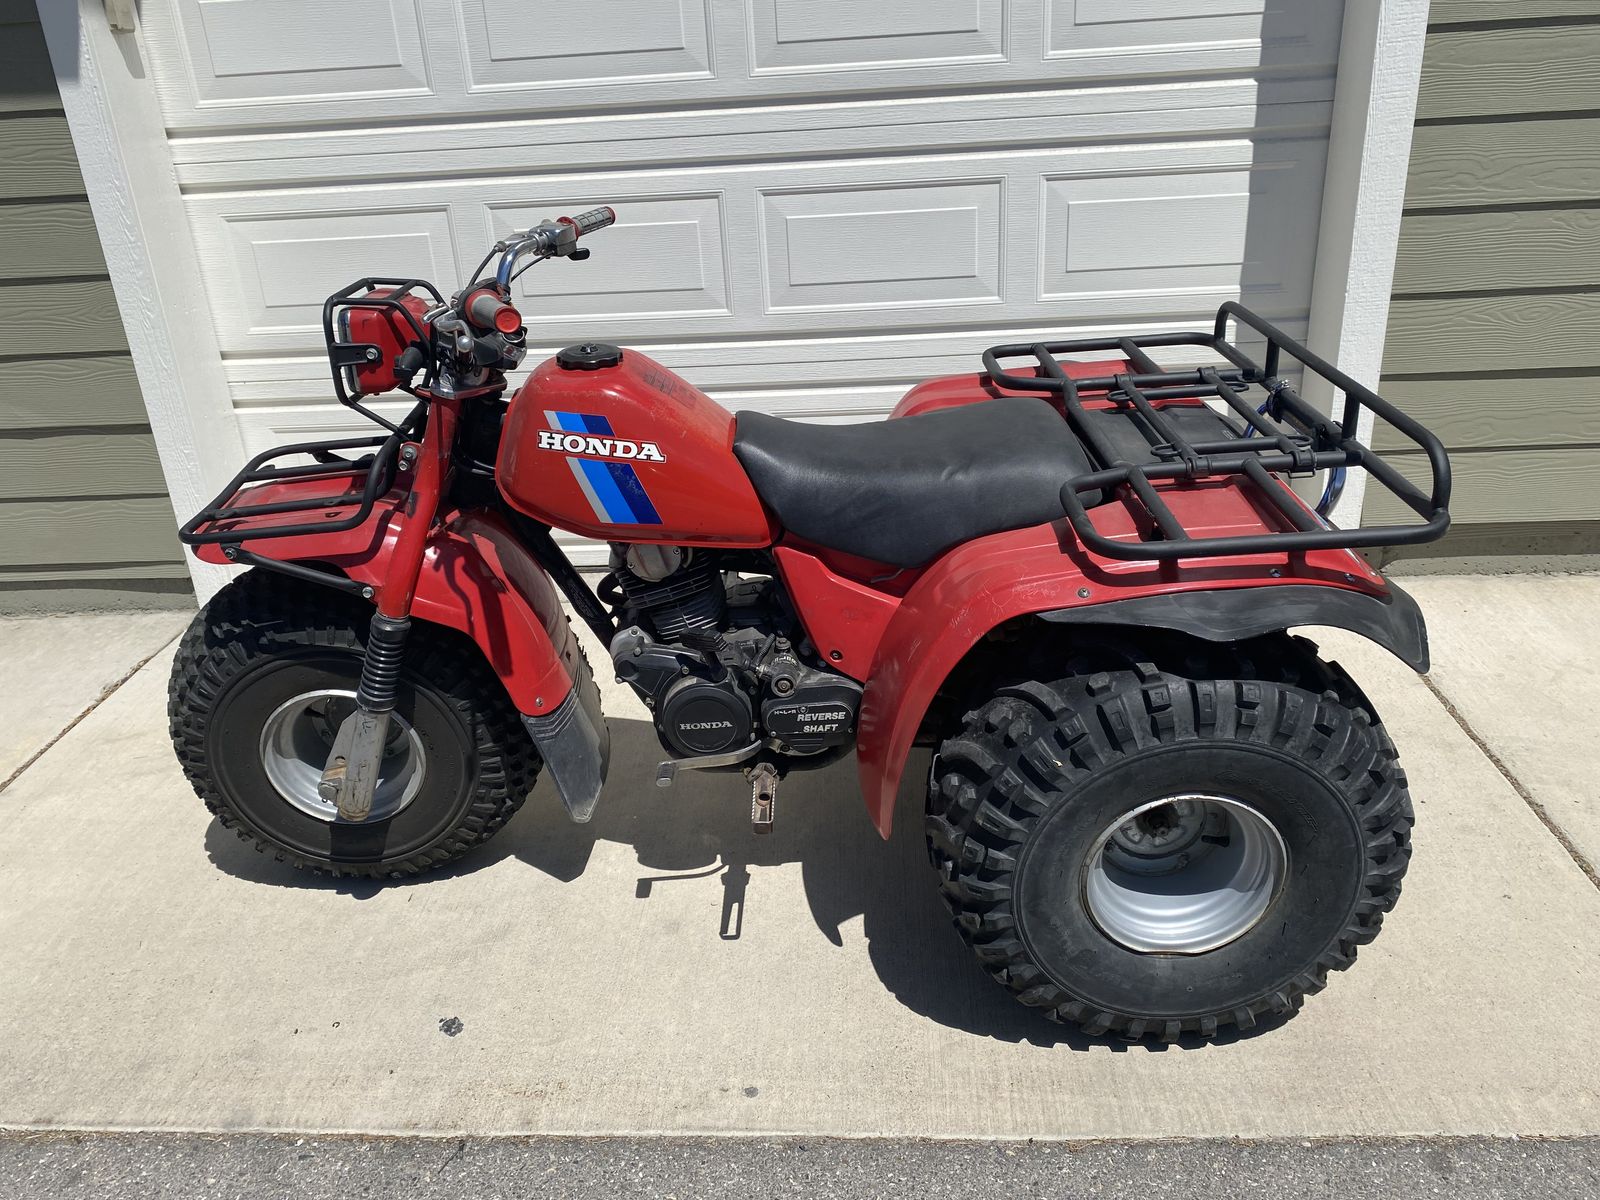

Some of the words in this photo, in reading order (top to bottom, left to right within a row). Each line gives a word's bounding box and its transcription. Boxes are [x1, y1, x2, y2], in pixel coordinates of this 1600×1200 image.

[538, 431, 665, 462] HONDA
[796, 711, 846, 722] REVERSE
[679, 719, 734, 731] HONDA
[803, 723, 839, 733] SHAFT
